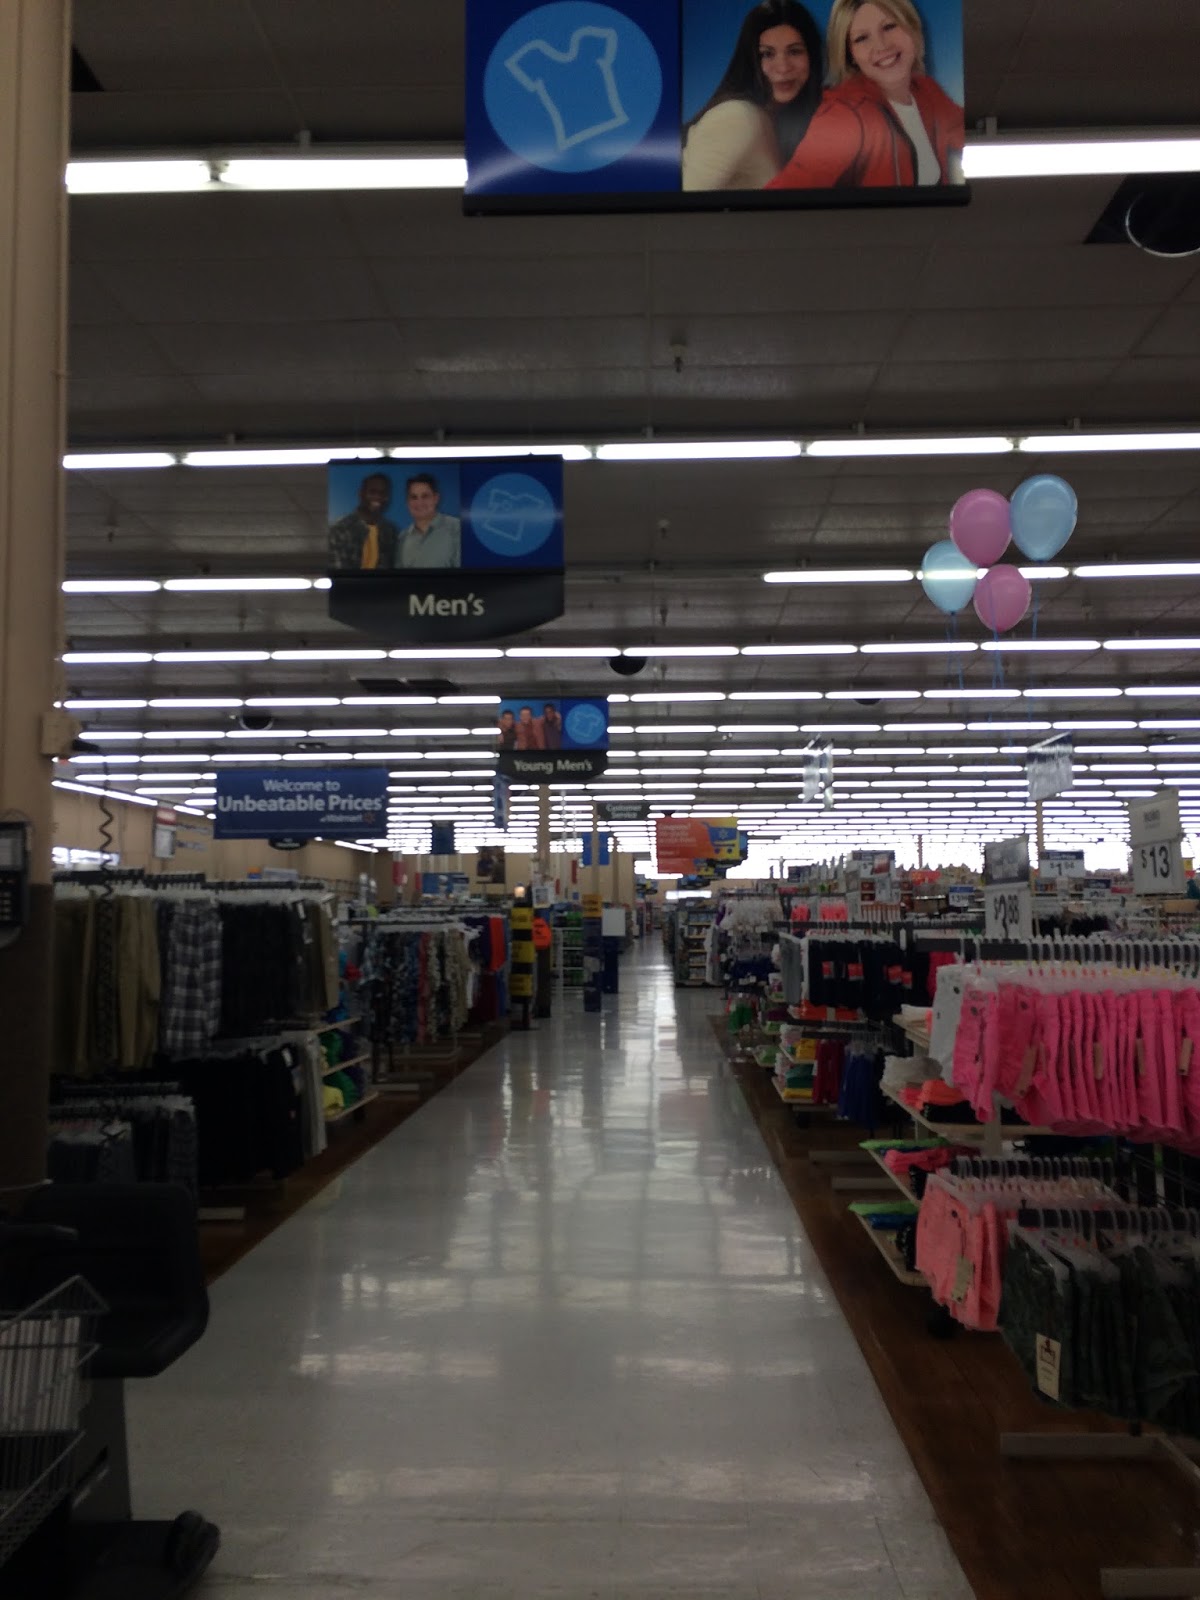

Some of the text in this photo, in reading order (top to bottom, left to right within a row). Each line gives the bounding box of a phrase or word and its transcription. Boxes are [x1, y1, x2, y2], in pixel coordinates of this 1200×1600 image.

[409, 593, 485, 616] Men's
[513, 758, 593, 774] Young Men's
[263, 779, 341, 792] Welcome to
[218, 794, 383, 812] Unbeatable Prices
